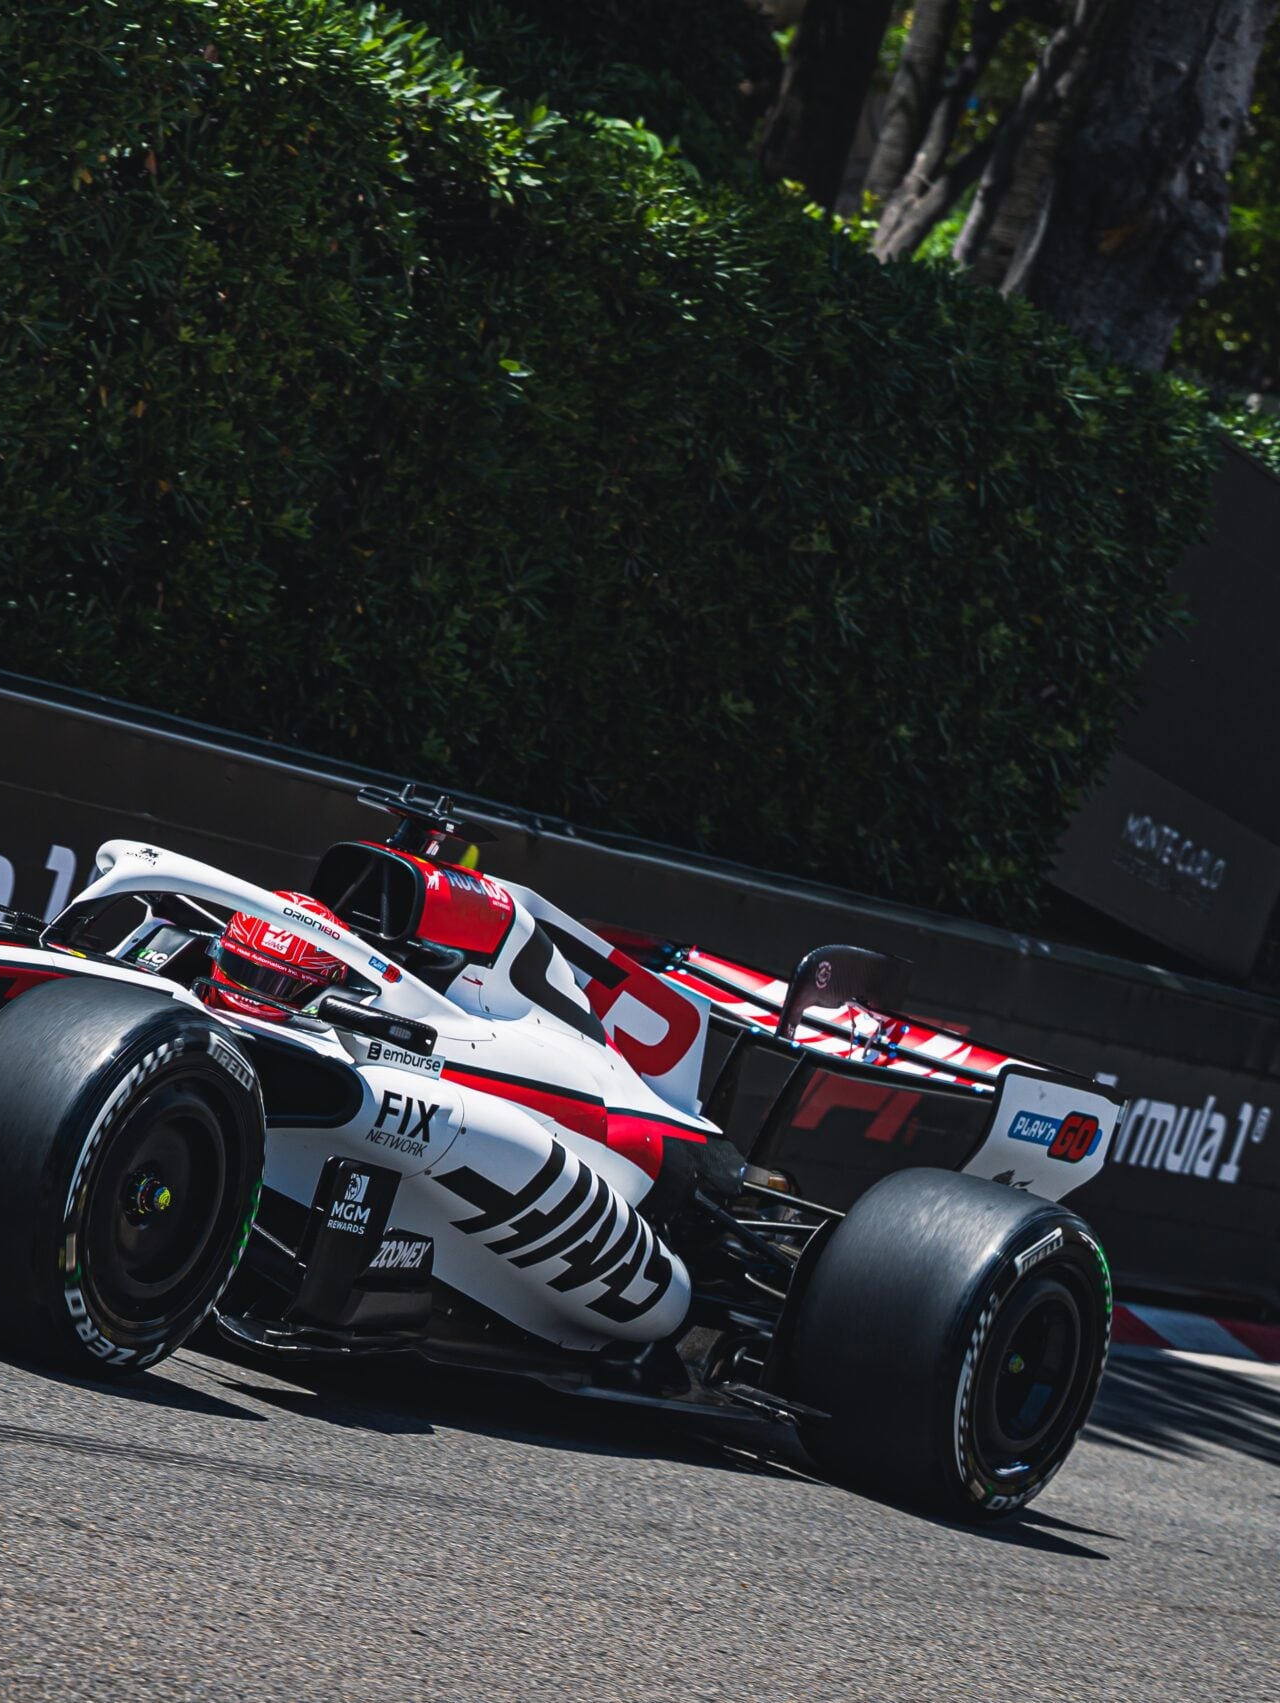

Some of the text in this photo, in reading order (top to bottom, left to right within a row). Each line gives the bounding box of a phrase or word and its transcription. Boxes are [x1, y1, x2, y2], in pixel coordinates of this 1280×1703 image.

[207, 1031, 255, 1092] PIRELLI
[383, 1047, 441, 1072] emburse
[374, 1089, 440, 1143] FIX
[365, 1128, 428, 1158] NETWORK
[1051, 1115, 1098, 1160] GO
[1113, 1095, 1227, 1179] rmula
[327, 1219, 365, 1235] REWARDS
[330, 1200, 371, 1224] MGM
[432, 1138, 673, 1324] HAAS
[369, 1240, 432, 1268] ZOOMEX
